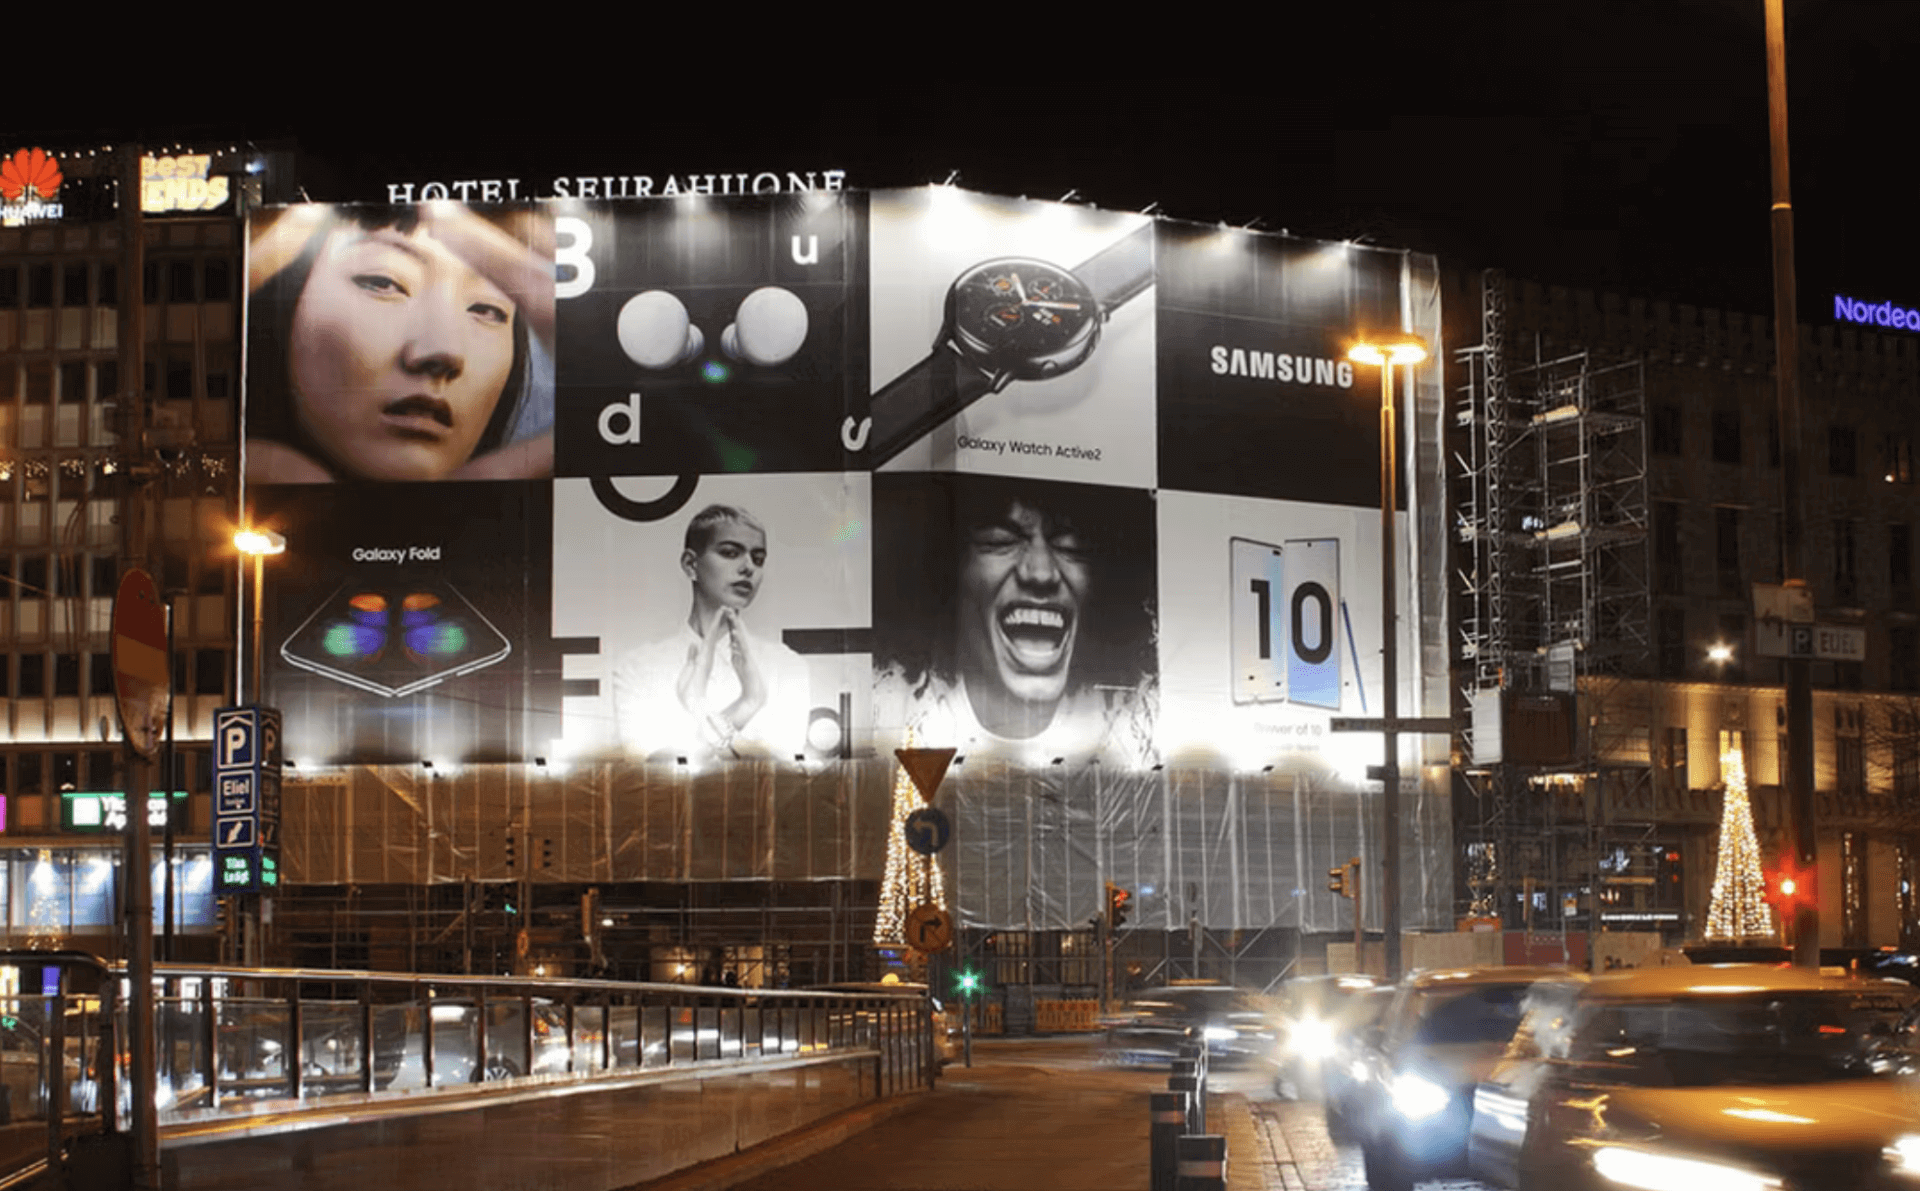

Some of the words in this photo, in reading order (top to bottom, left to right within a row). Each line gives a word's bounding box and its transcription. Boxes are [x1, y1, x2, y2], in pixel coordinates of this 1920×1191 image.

[791, 235, 818, 265] u
[1834, 294, 1920, 331] Nordea
[1211, 345, 1353, 388] SAMSUNG
[597, 392, 641, 445] d
[957, 435, 1006, 456] Galaxy
[1009, 440, 1052, 457] Watch
[1055, 445, 1102, 461] Active2
[352, 547, 407, 564] Galaxy
[409, 546, 441, 560] Fold
[1250, 578, 1333, 665] 10
[226, 727, 246, 764] P
